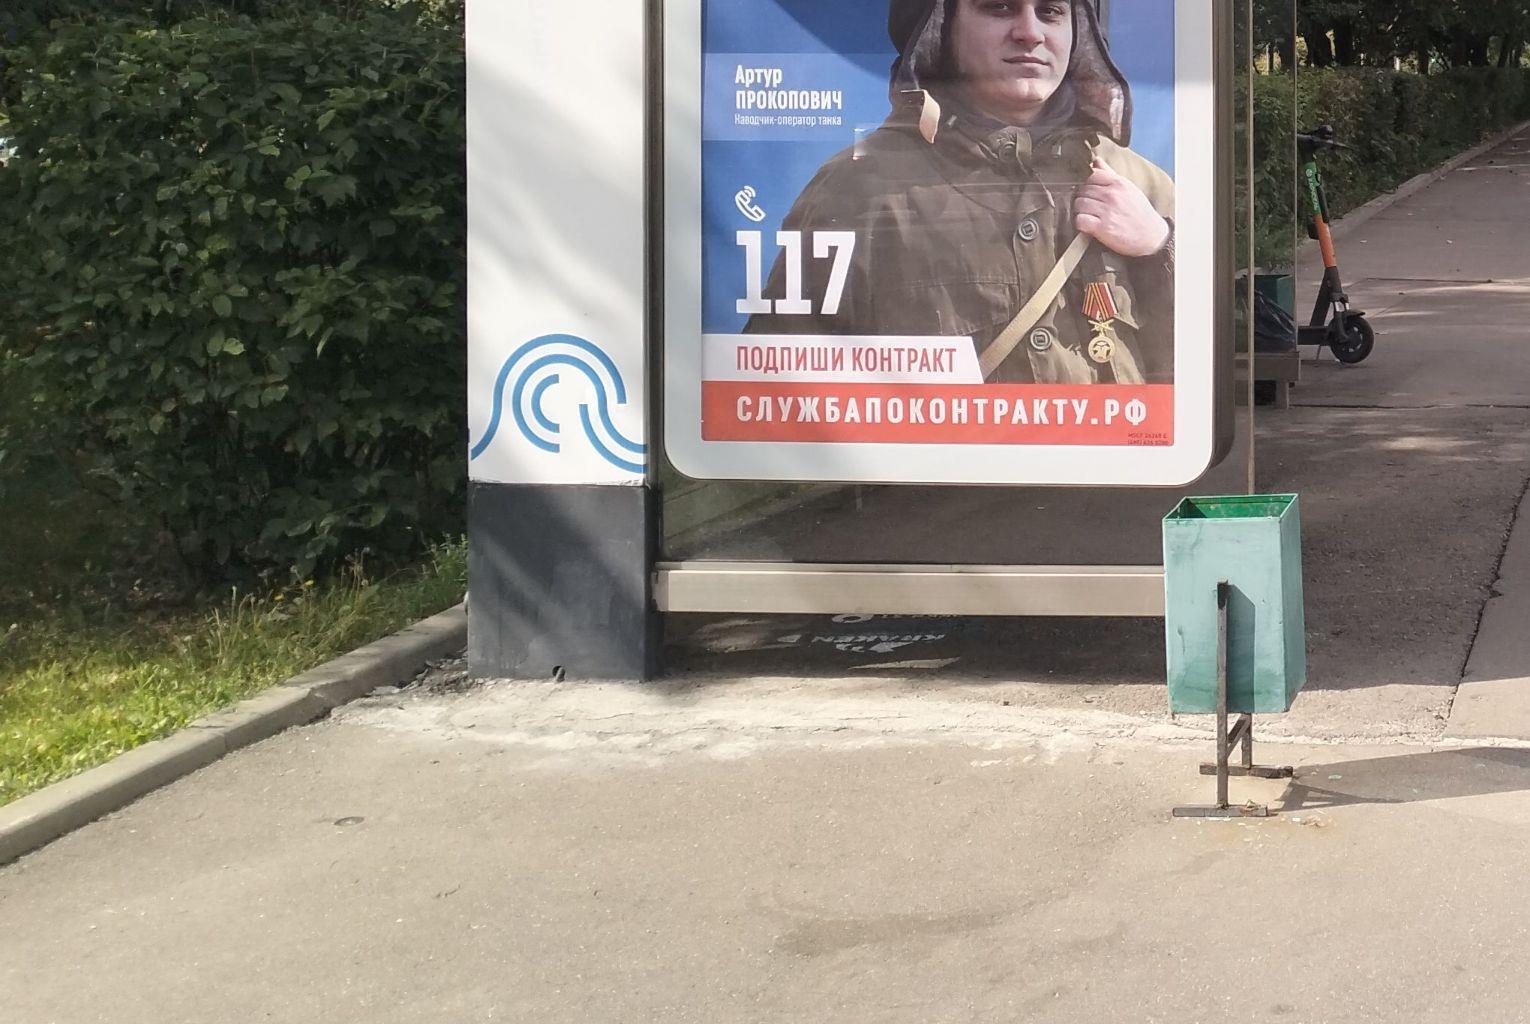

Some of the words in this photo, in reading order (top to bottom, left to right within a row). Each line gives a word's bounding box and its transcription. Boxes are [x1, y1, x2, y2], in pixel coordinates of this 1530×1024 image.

[735, 65, 783, 88] Артур
[735, 90, 842, 110] ПРОКОПОВИЧ
[734, 114, 816, 127] Наводчик-оператор
[818, 116, 842, 126] танка
[735, 230, 856, 315] 117
[736, 346, 844, 374] ПОДПИШИ
[851, 347, 957, 373] КОНТРАКТ
[736, 395, 1148, 427] СЛУЖБАПОКОНТРАКТУ.РФ
